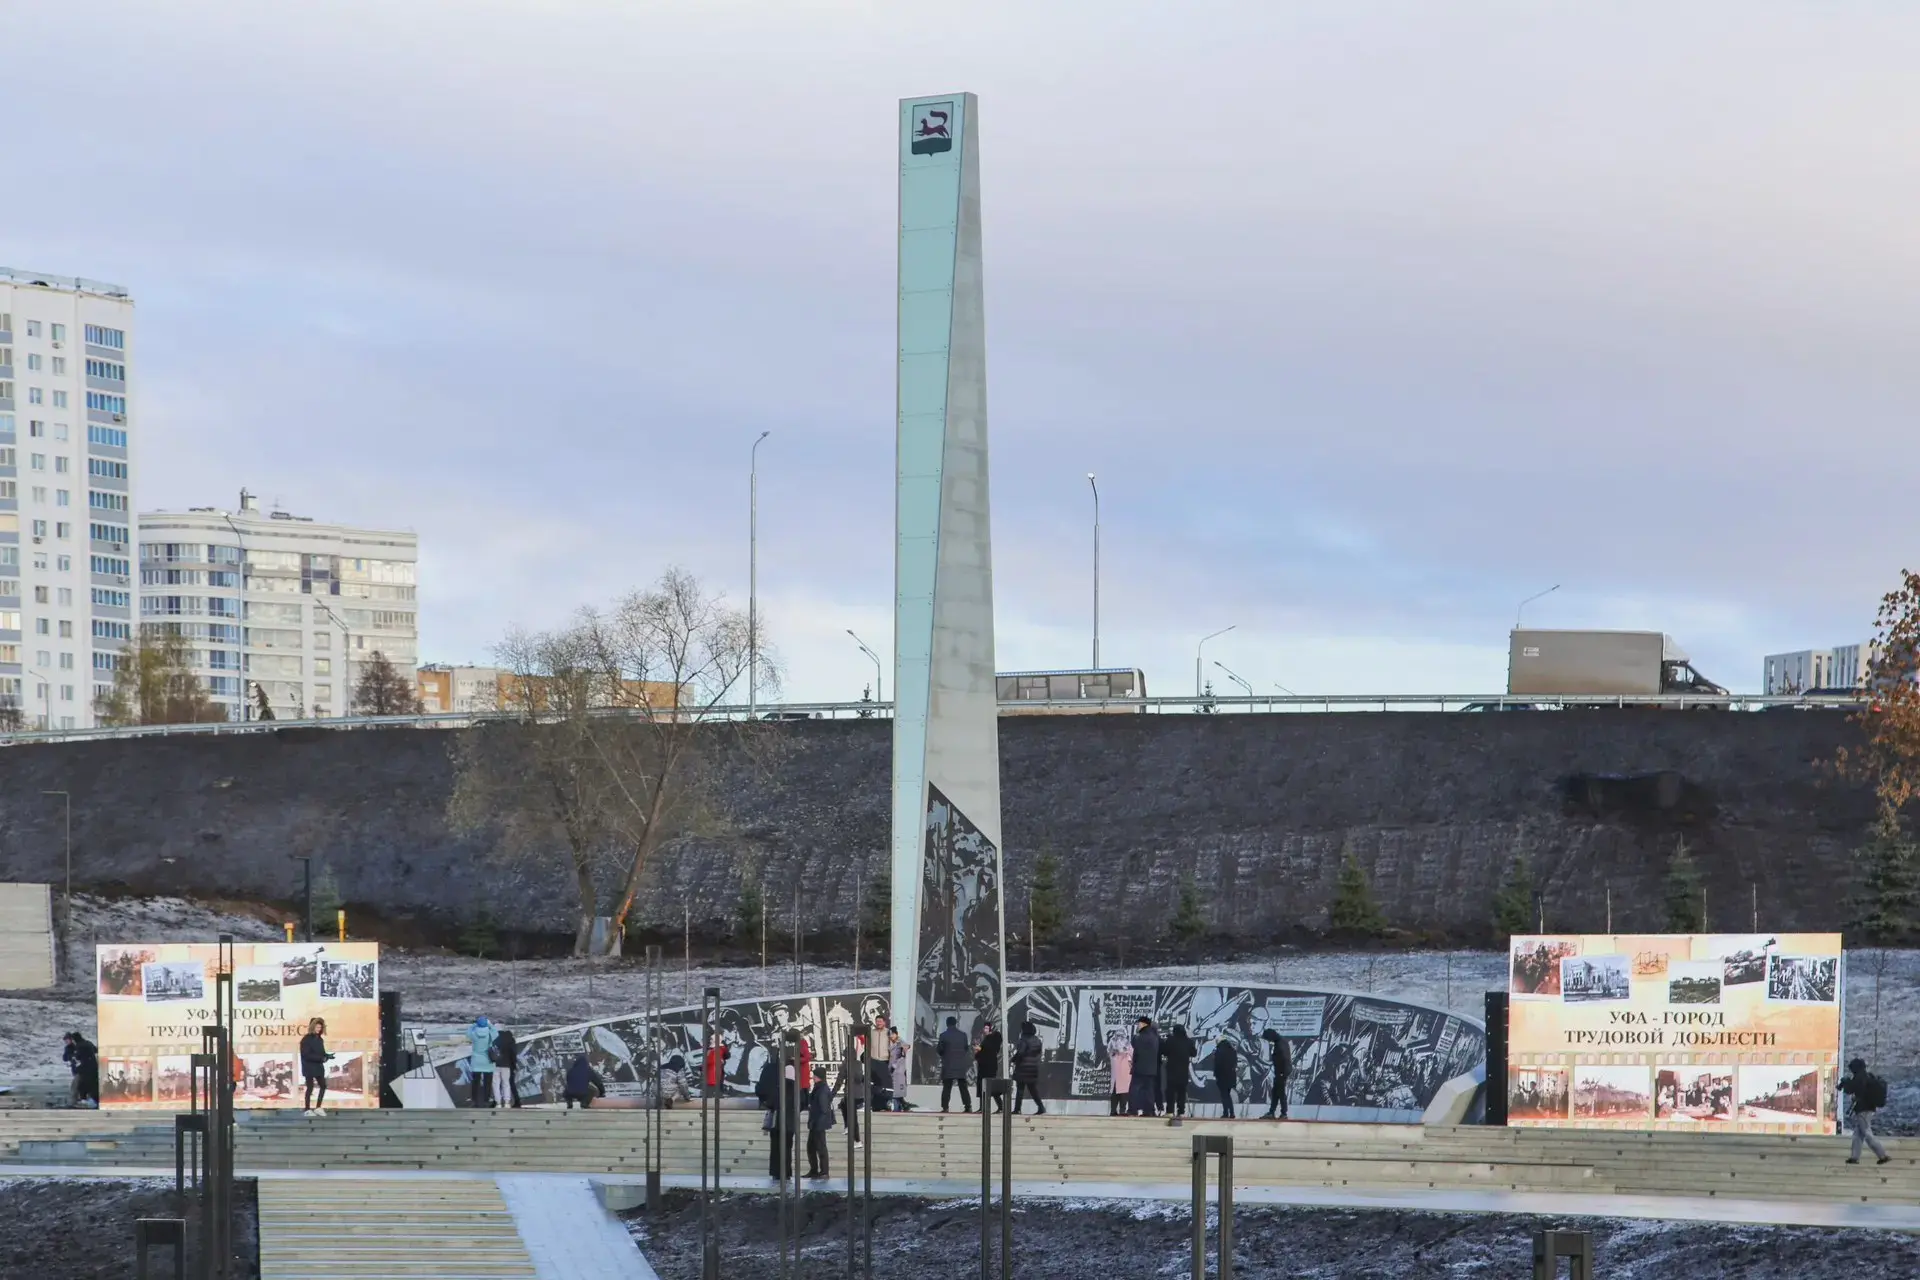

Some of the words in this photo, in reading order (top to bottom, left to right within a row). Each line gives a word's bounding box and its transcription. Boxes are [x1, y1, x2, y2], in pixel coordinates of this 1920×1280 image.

[232, 1008, 285, 1021] ГОРОД
[1609, 1011, 1647, 1024] УФА
[1663, 1011, 1725, 1027] ГОРОД
[241, 1025, 327, 1038] ДОБЛЕС
[1564, 1028, 1664, 1046] ТРУДОВОЙ
[1672, 1032, 1776, 1046] ДОБЛЕСТИ
